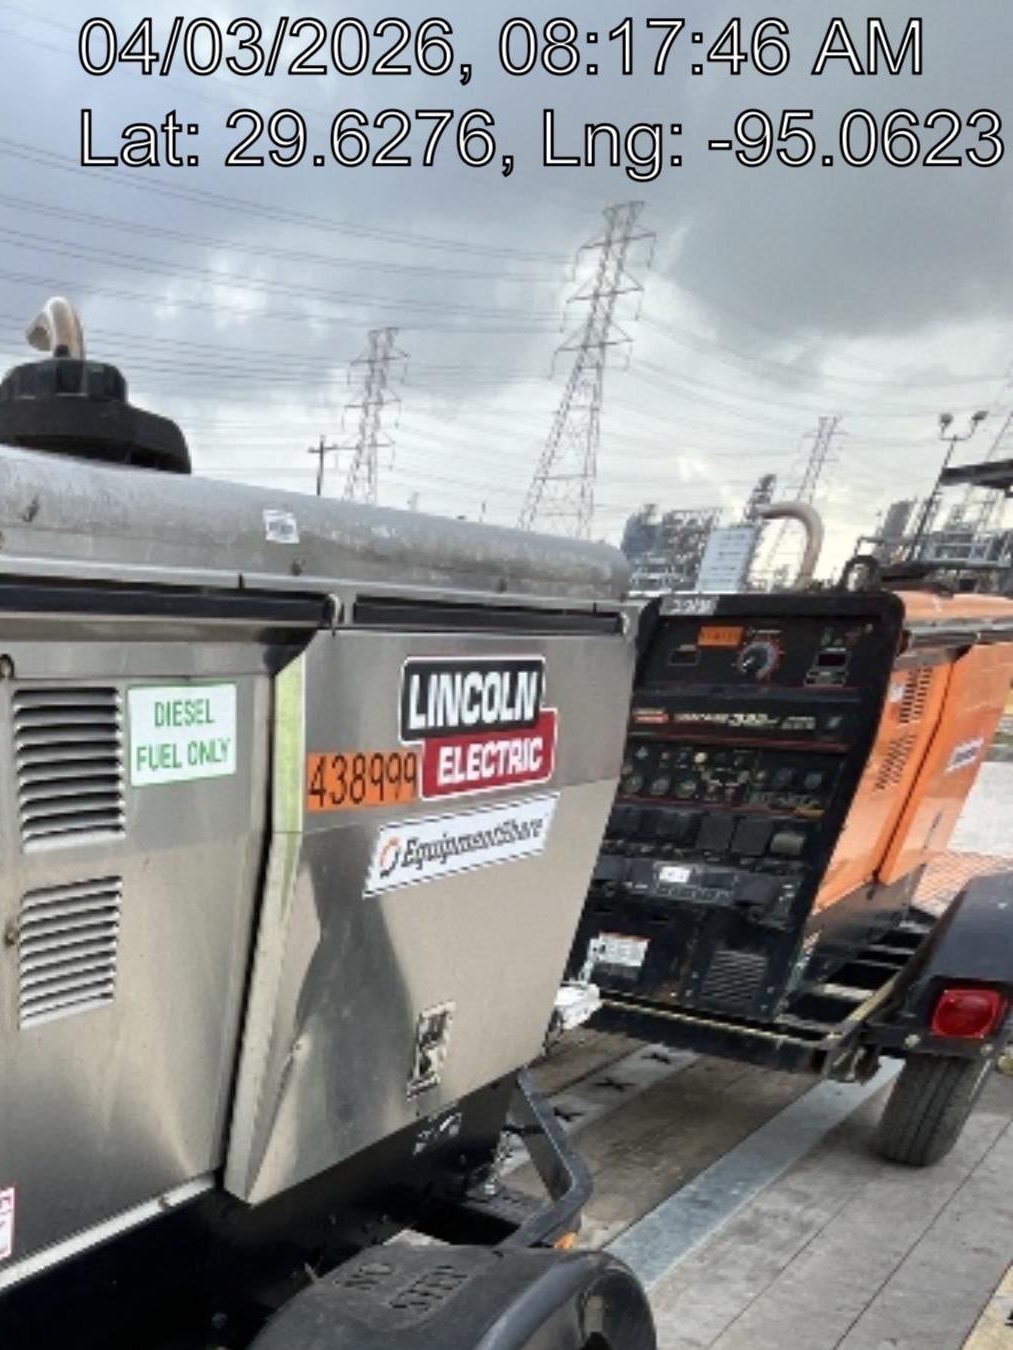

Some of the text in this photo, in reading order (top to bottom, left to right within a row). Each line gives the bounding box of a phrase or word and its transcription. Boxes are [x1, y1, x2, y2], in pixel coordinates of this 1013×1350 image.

[154, 699, 215, 728] DIESEL
[409, 671, 539, 730] LINCOLN
[136, 738, 232, 772] FUEL ONLY
[307, 751, 418, 809] 438999
[438, 737, 543, 787] ELECTRIC
[400, 816, 544, 870] EquipmentShare
